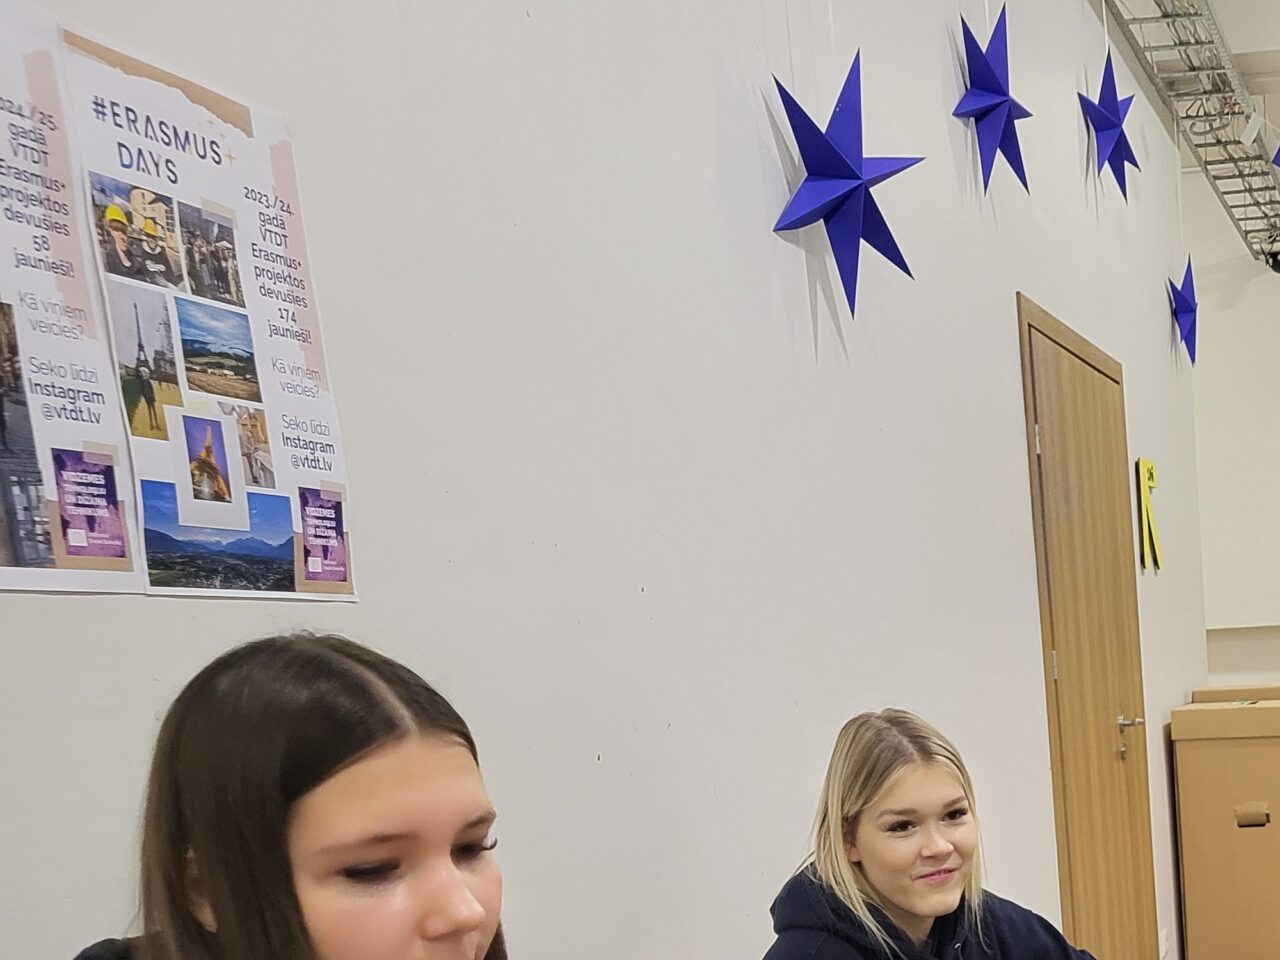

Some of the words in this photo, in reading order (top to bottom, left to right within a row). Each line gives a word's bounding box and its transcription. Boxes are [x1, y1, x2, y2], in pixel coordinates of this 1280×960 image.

[92, 95, 222, 165] #ERASMUS
[8, 138, 50, 168] VTDT
[117, 141, 179, 185] DAYS
[258, 211, 286, 231] gadā
[32, 234, 51, 252] 58
[258, 226, 289, 249] VTDT
[251, 242, 302, 271] Erasmus+
[254, 265, 306, 291] projektos
[258, 282, 308, 309] devušies
[278, 308, 297, 325] 174
[28, 356, 68, 379] Seko
[28, 377, 105, 406] Instagram
[281, 414, 309, 434] Seko
[281, 431, 336, 456] Instagram
